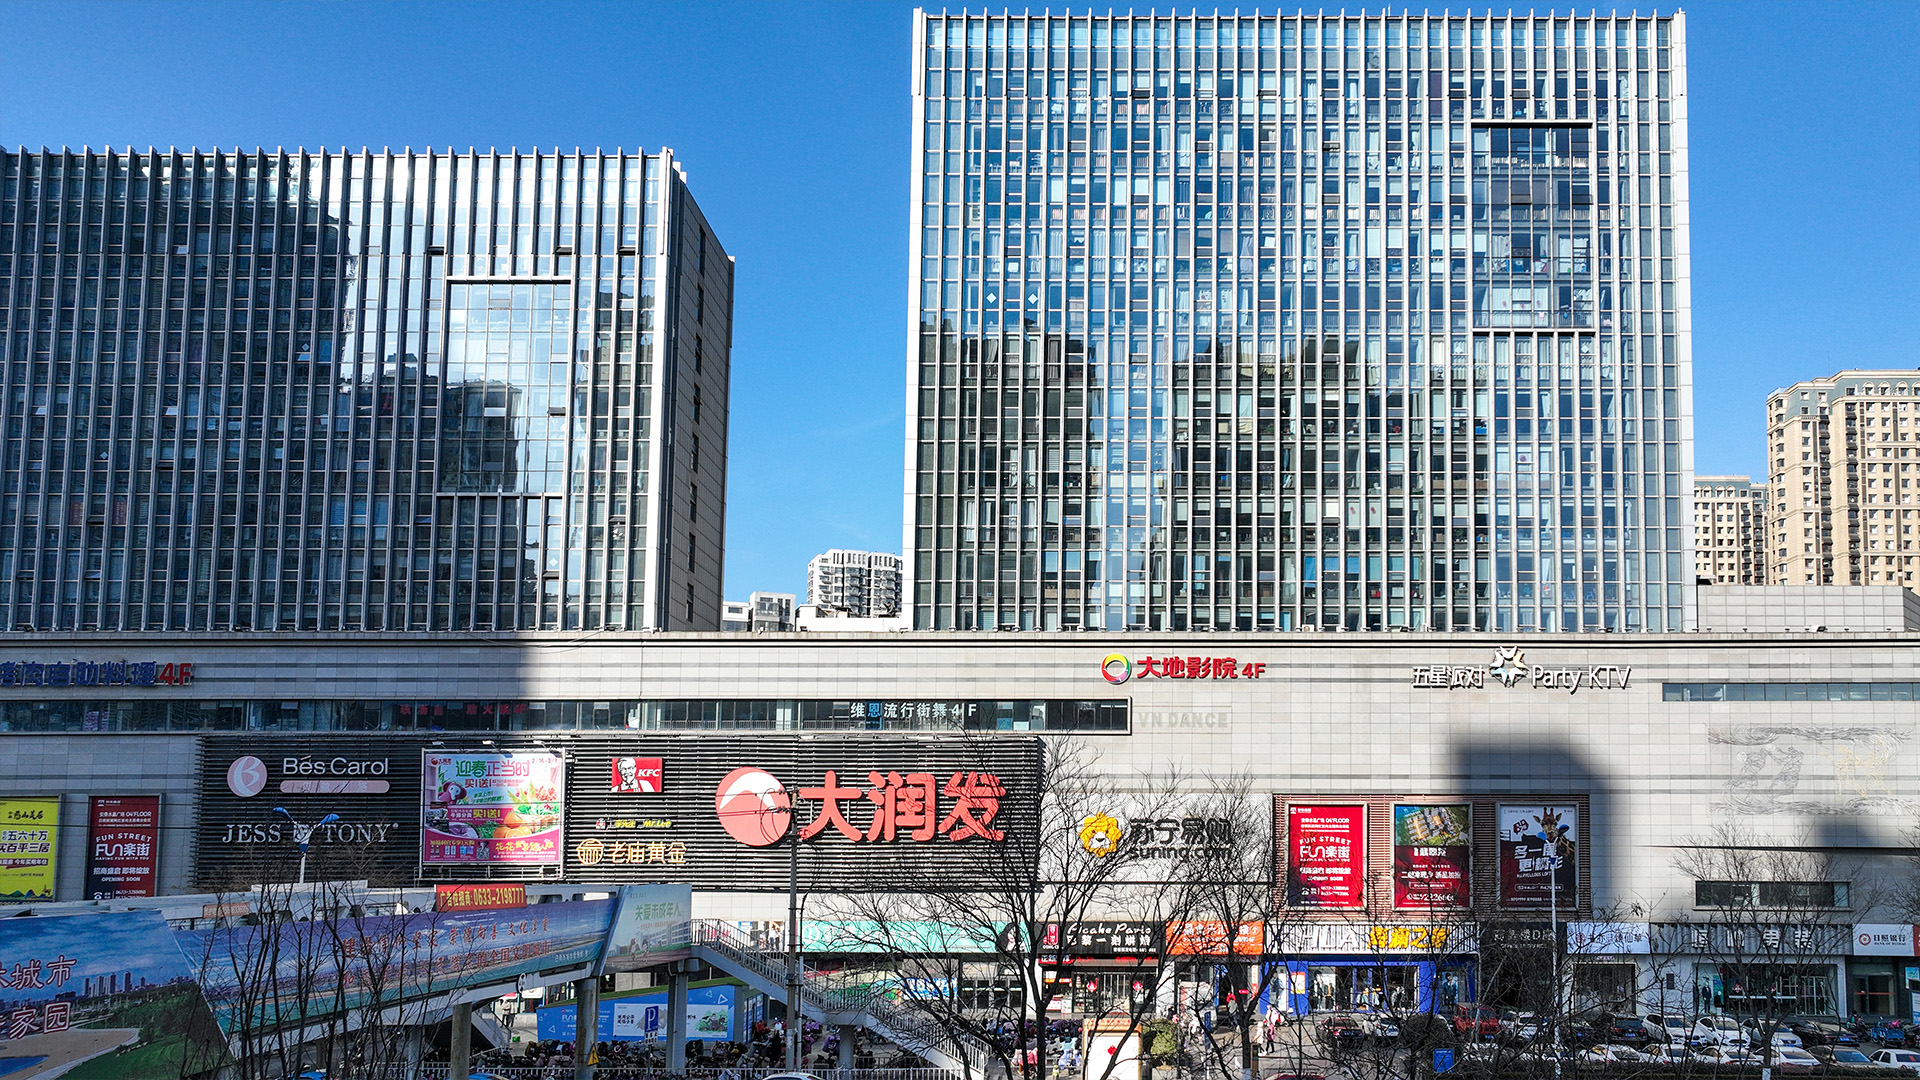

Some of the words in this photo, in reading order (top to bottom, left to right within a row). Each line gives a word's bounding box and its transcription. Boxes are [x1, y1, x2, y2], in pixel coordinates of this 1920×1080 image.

[159, 662, 193, 686] 4F
[1137, 656, 1238, 679] 大地影院
[1242, 663, 1266, 678] 4F
[1413, 665, 1485, 689] 五星派对
[1532, 665, 1582, 694] Party
[1589, 665, 1632, 688] KTV
[850, 703, 948, 718] 维恩流行街舞
[1139, 712, 1163, 728] VN
[1168, 712, 1228, 728] DANCE
[283, 755, 325, 775] Bés
[331, 757, 388, 775] Carol
[456, 760, 530, 777] 迎春正当时
[637, 769, 660, 777] KFC
[799, 770, 1006, 841] 大润发
[96, 834, 114, 843] FUN
[118, 832, 152, 843] STREET
[222, 824, 281, 843] JESS
[1319, 836, 1352, 846] STREET
[608, 841, 687, 864] 老庙黄金
[635, 902, 681, 921] 关爱未成年人
[1303, 927, 1359, 949] HLA
[1873, 934, 1906, 942] 日照银行
[0, 1001, 72, 1040] 家园
[647, 1007, 656, 1031] P
